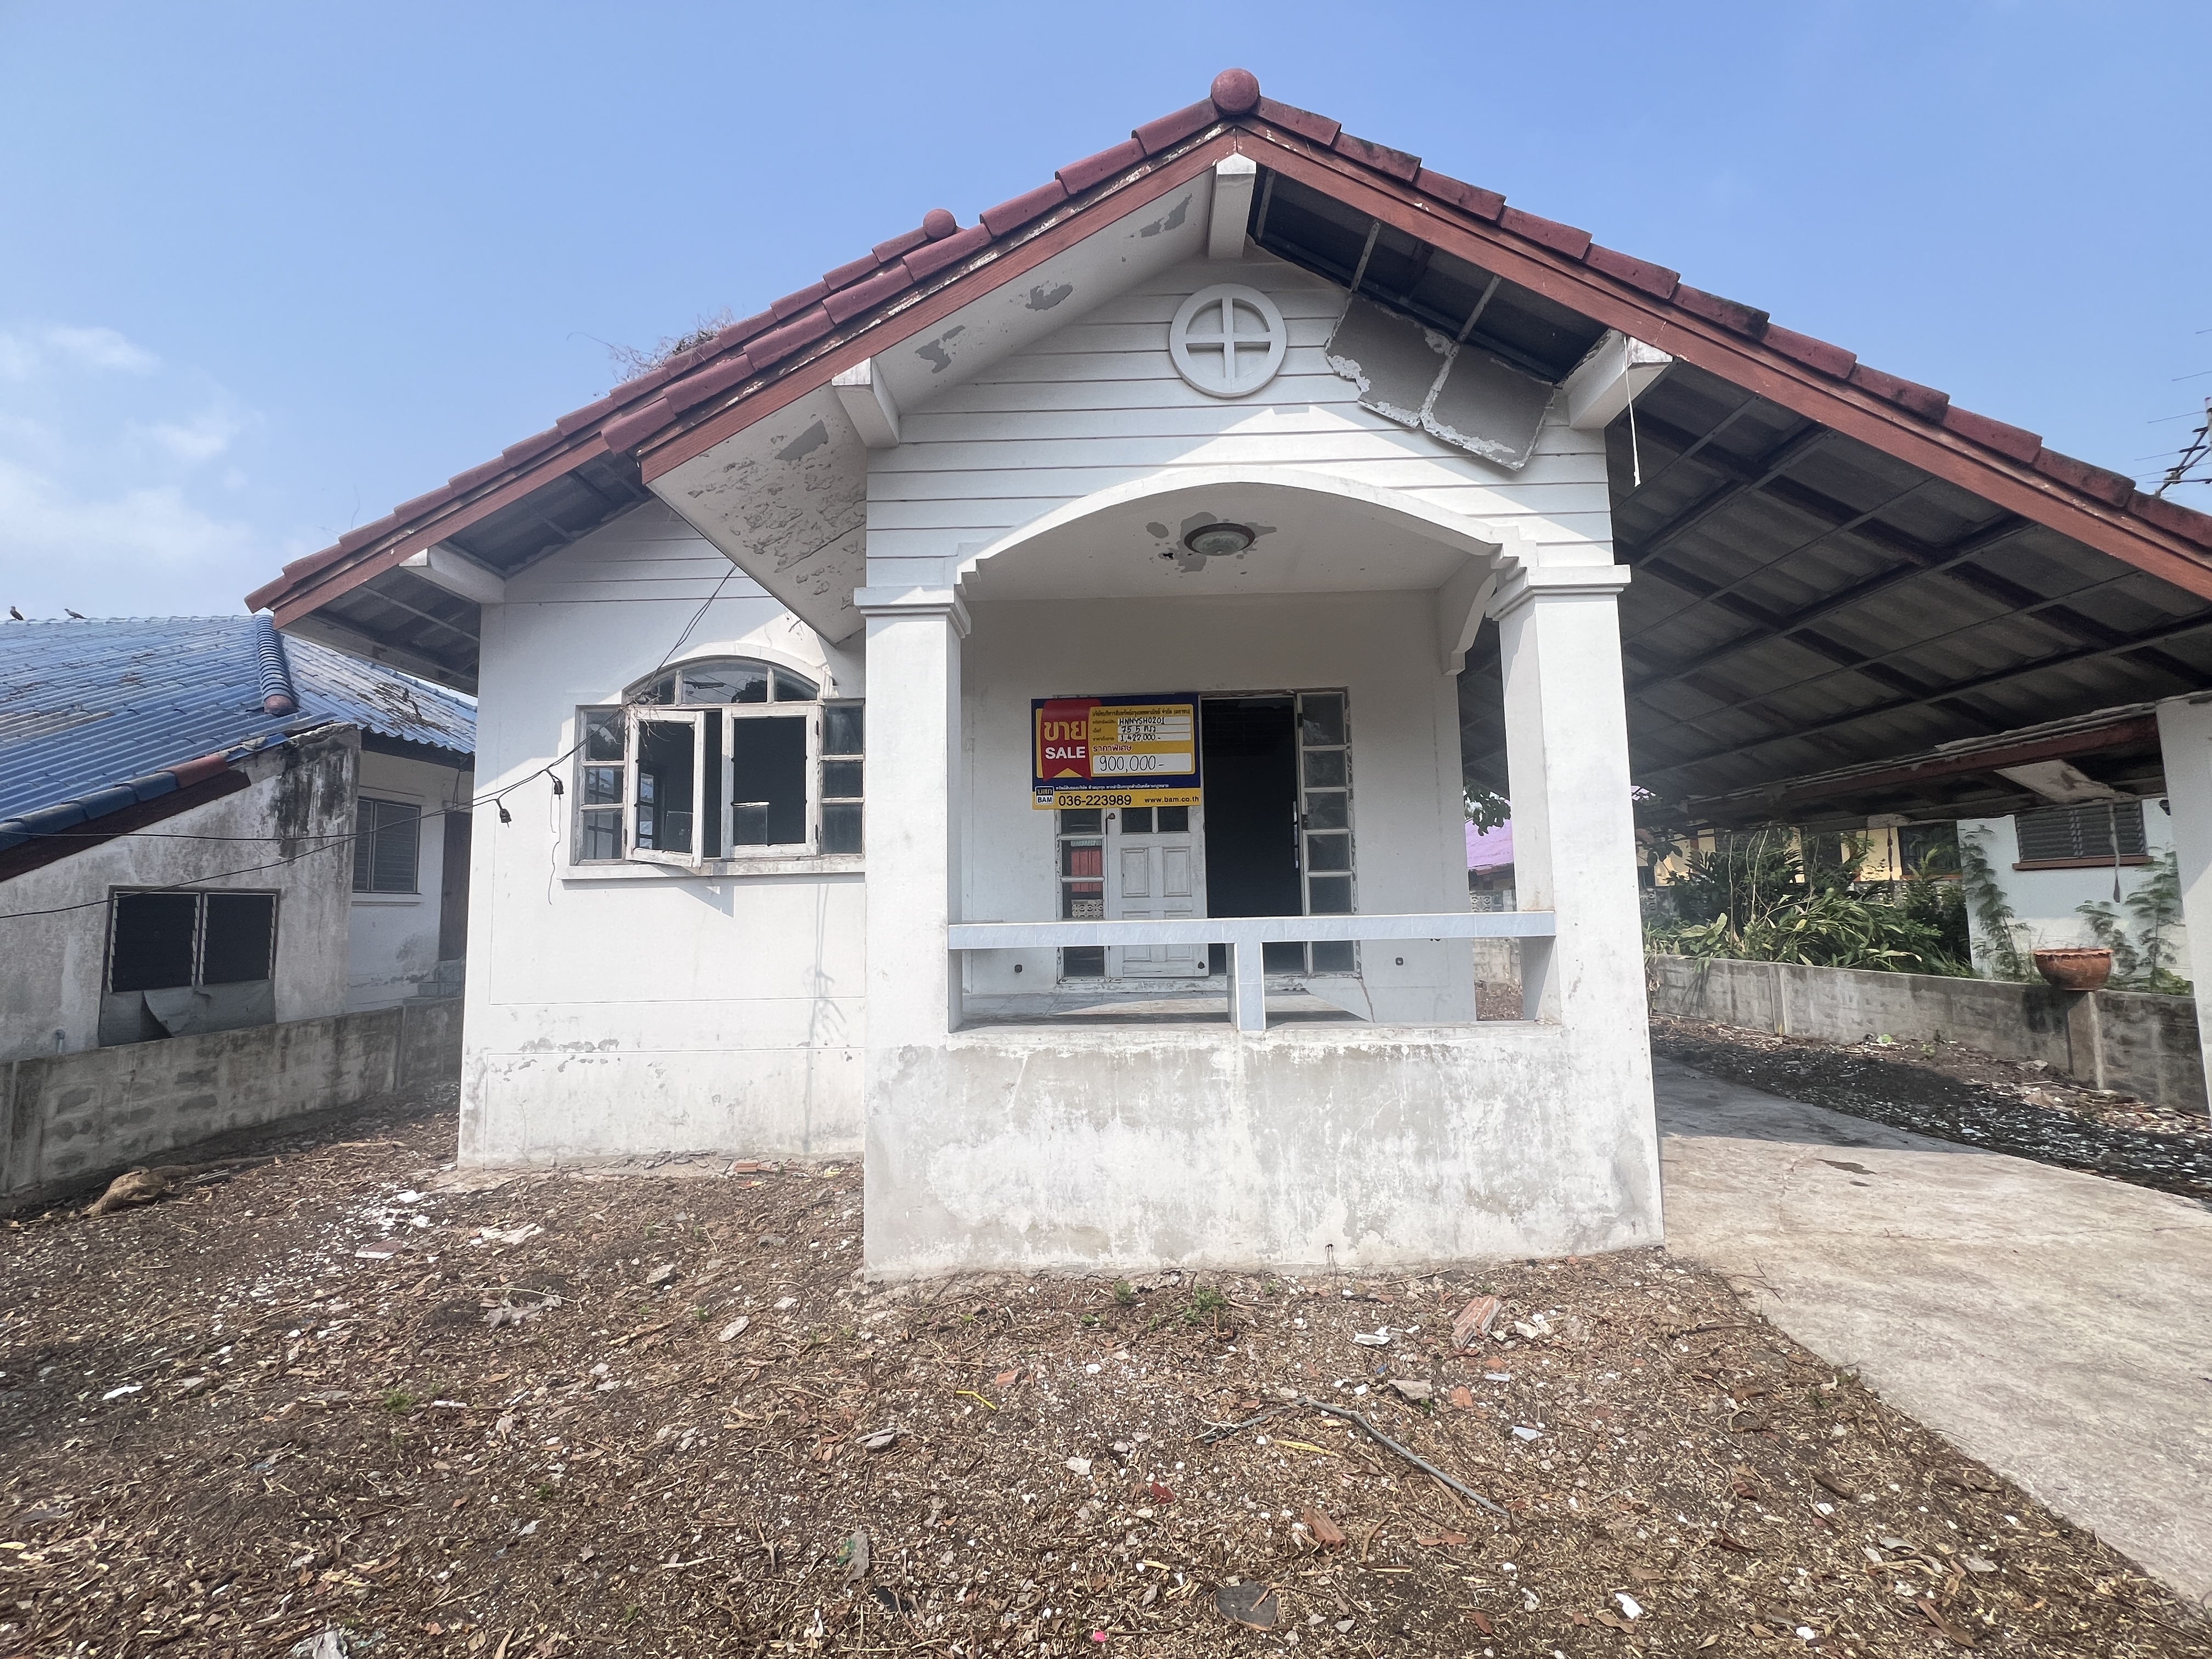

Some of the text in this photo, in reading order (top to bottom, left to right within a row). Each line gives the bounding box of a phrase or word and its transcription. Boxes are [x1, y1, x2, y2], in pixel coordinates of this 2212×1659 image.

[1043, 720, 1086, 741] ขาย
[1045, 746, 1086, 760] SALE
[1092, 744, 1132, 753] ราคาพิเศษ
[1058, 794, 1132, 807] 036-223989
